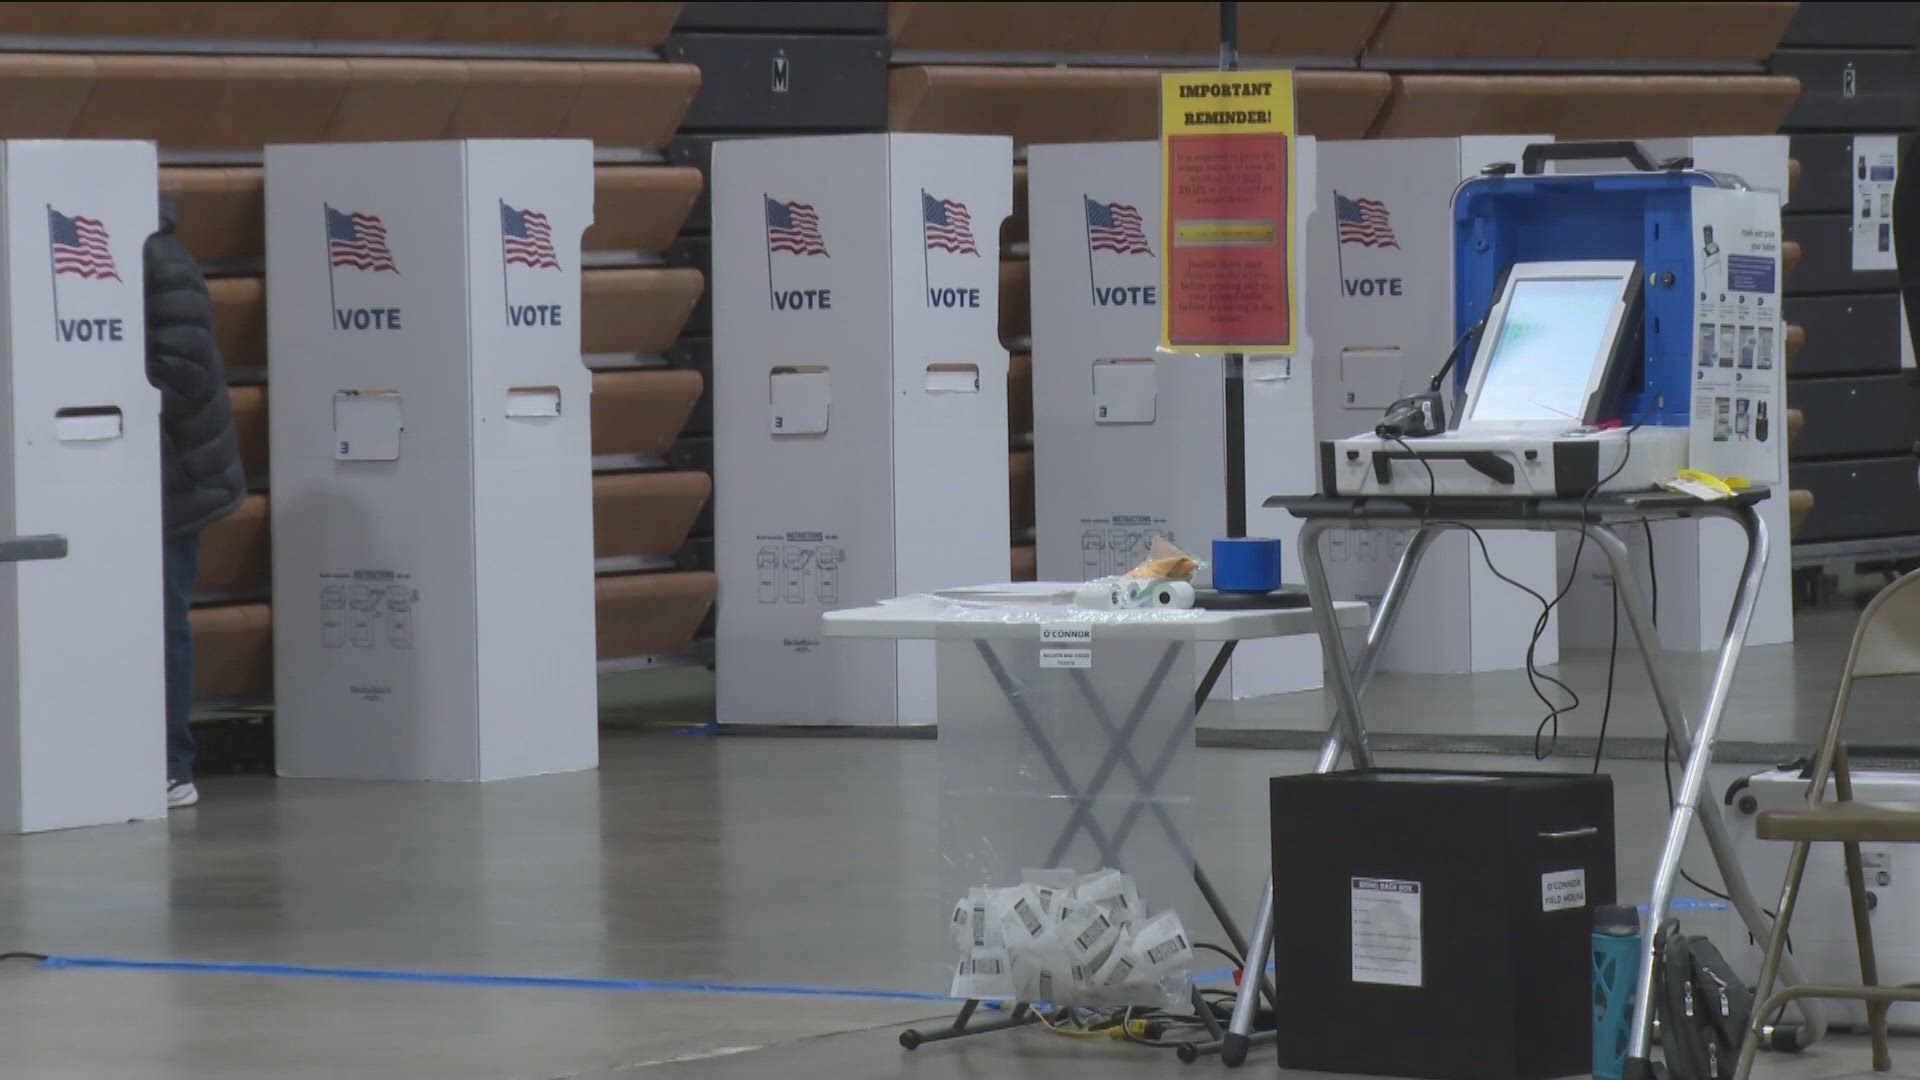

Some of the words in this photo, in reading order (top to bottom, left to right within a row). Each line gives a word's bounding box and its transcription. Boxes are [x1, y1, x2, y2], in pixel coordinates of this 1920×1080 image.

[1179, 83, 1273, 98] IMPORTANT
[1184, 111, 1272, 126] REMINDER!
[1097, 287, 1157, 306] VOTE
[1346, 279, 1402, 297] VOTE
[774, 289, 831, 310] VOTE
[931, 289, 980, 308] VOTE
[338, 308, 402, 330] VOTE
[510, 305, 562, 326] VOTE
[60, 319, 123, 342] VOTE
[1043, 629, 1090, 638] O'CONNOR
